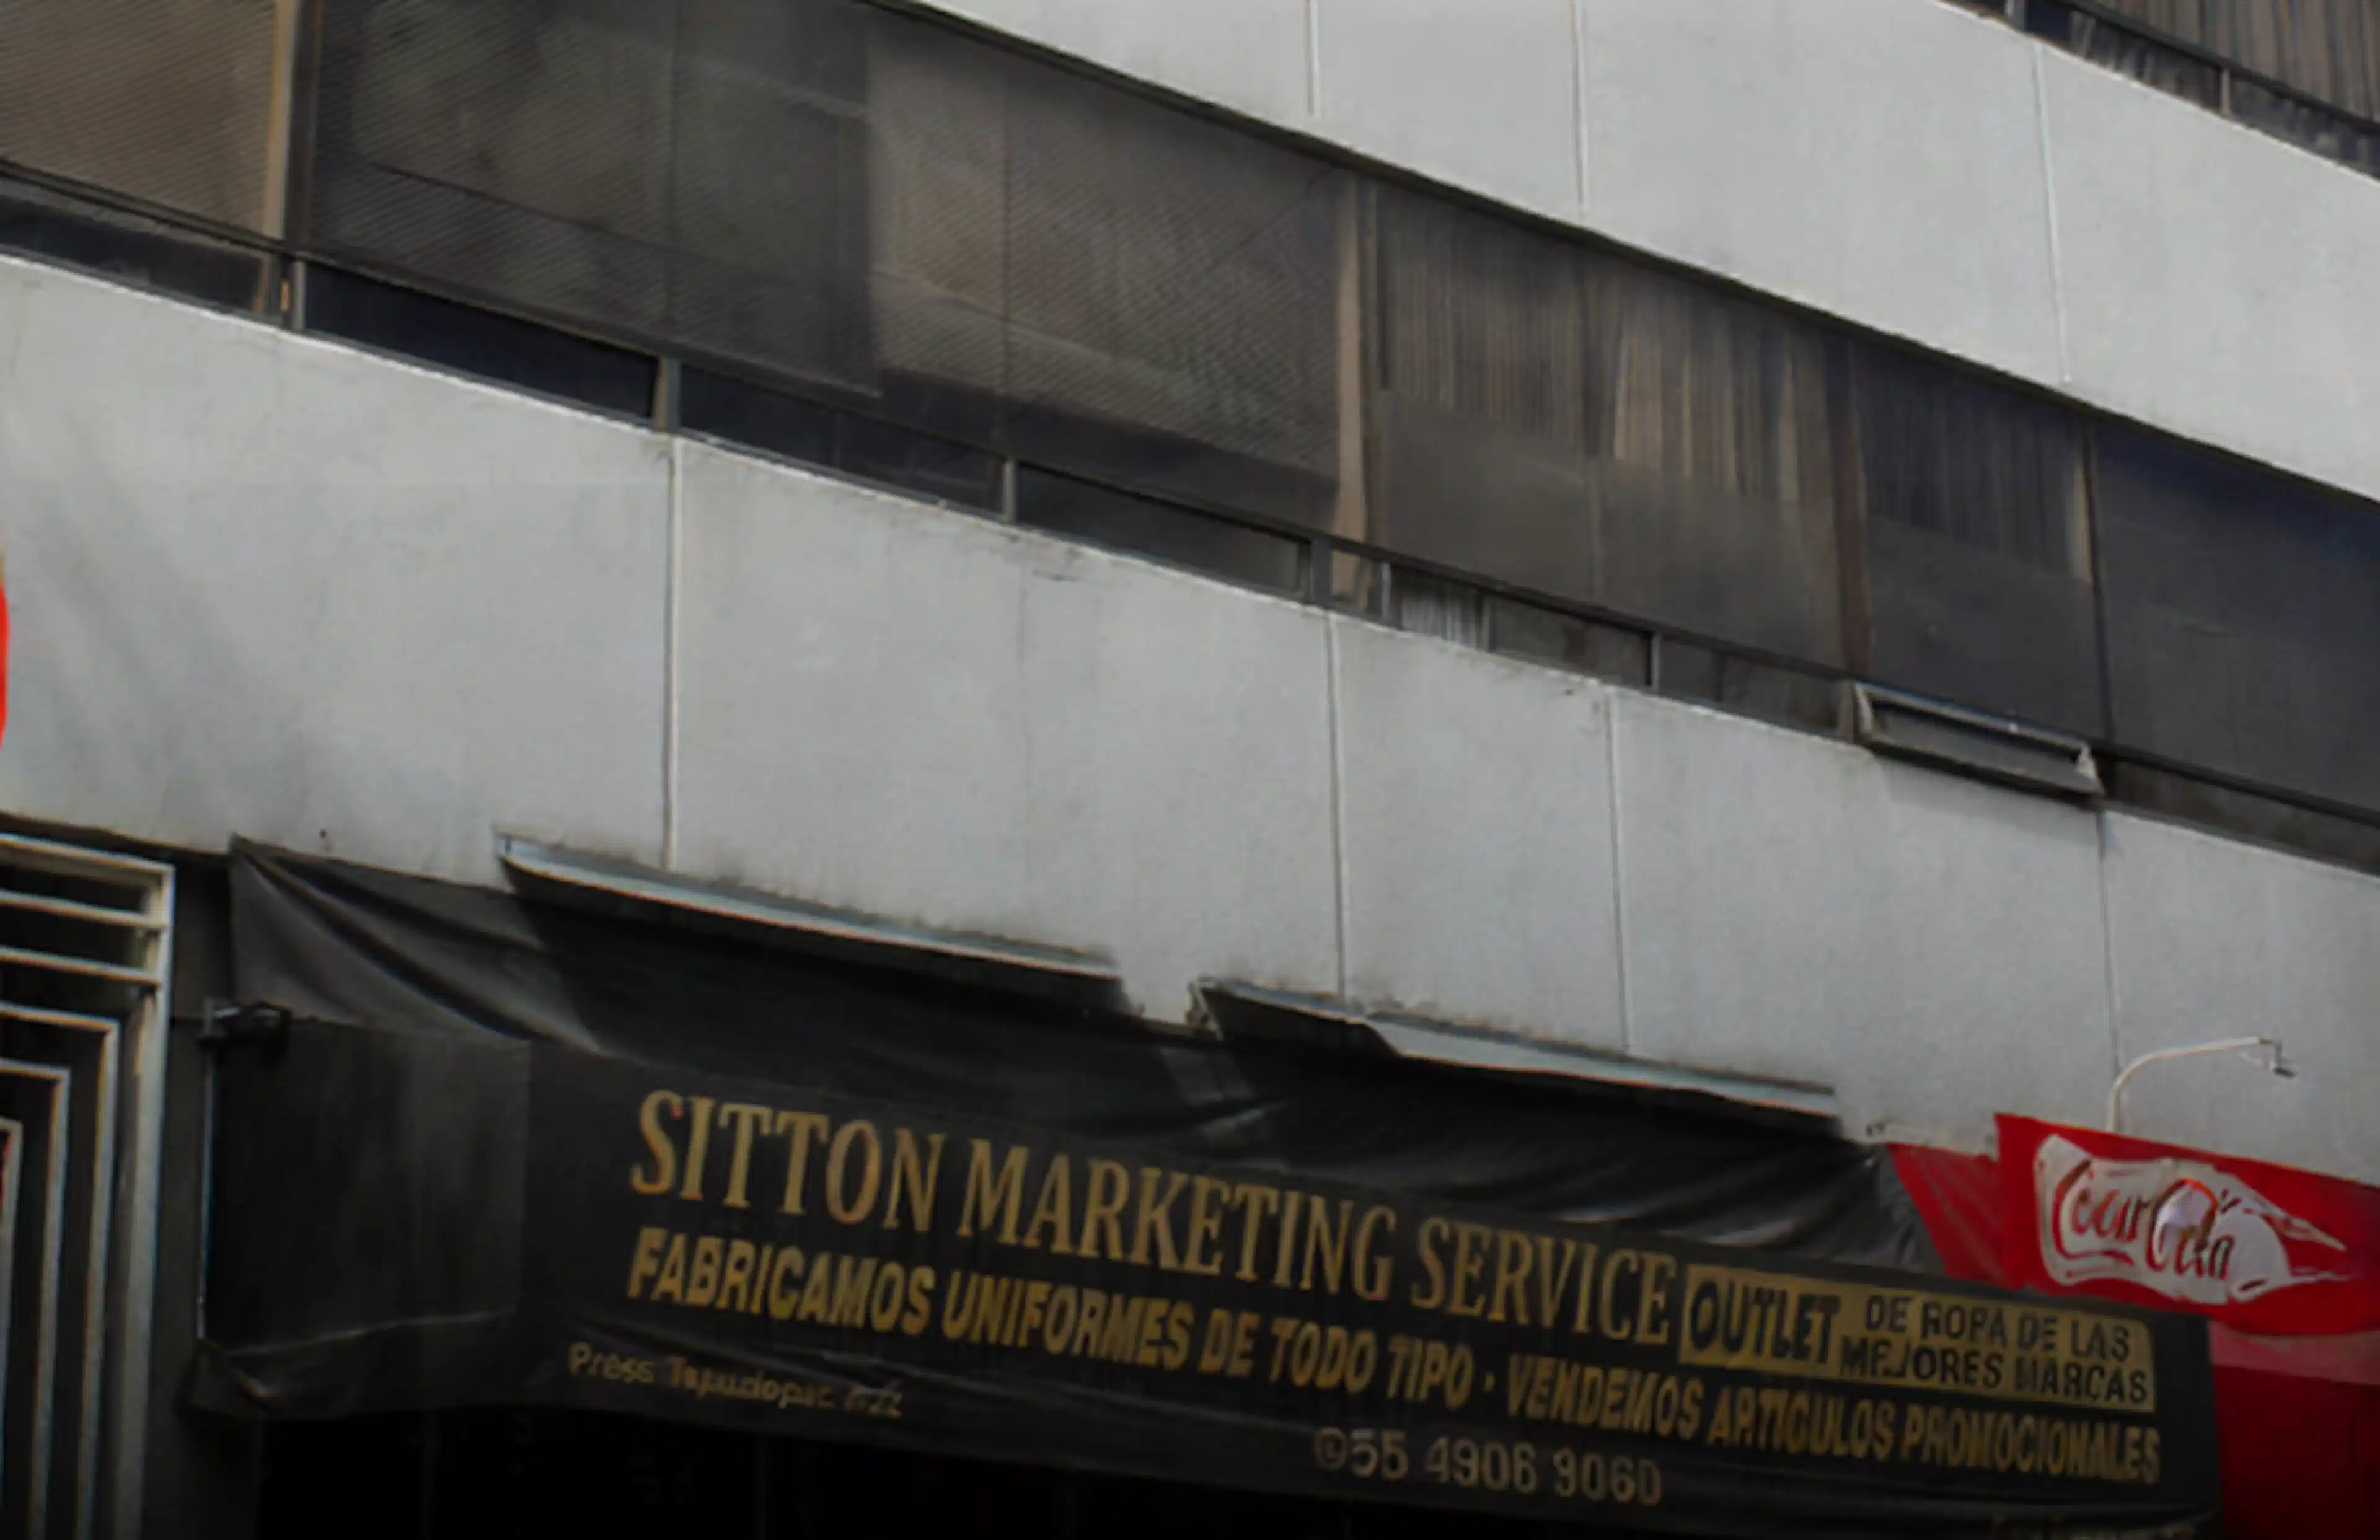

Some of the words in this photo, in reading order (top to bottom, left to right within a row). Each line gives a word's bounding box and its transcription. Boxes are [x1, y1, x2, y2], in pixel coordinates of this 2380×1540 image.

[630, 1090, 945, 1233] SITTON
[956, 1138, 1396, 1301] MARKETING
[1410, 1217, 1677, 1344] SERVICE
[627, 1228, 935, 1335] FABRICAMOS
[941, 1270, 1194, 1370] UNIFORMES
[1198, 1307, 1261, 1377] DE
[1270, 1317, 1377, 1394] TODO
[1386, 1333, 1473, 1410] TIPO
[1507, 1353, 1703, 1440] VENDEMOS
[1708, 1386, 1895, 1462] ARTICULOS
[1902, 1404, 2160, 1485] PROMOCIONALES
[1690, 1280, 1840, 1364] OUTLET
[1865, 1294, 1912, 1334] DE
[1922, 1302, 2008, 1349] ROPA
[2019, 1314, 2058, 1352] DE
[2071, 1319, 2130, 1362] LAS
[1841, 1335, 2003, 1389] MEJORES
[2015, 1357, 2148, 1404] MARCAS
[1427, 1437, 1538, 1494] 4906
[1553, 1447, 1664, 1506] 9060
